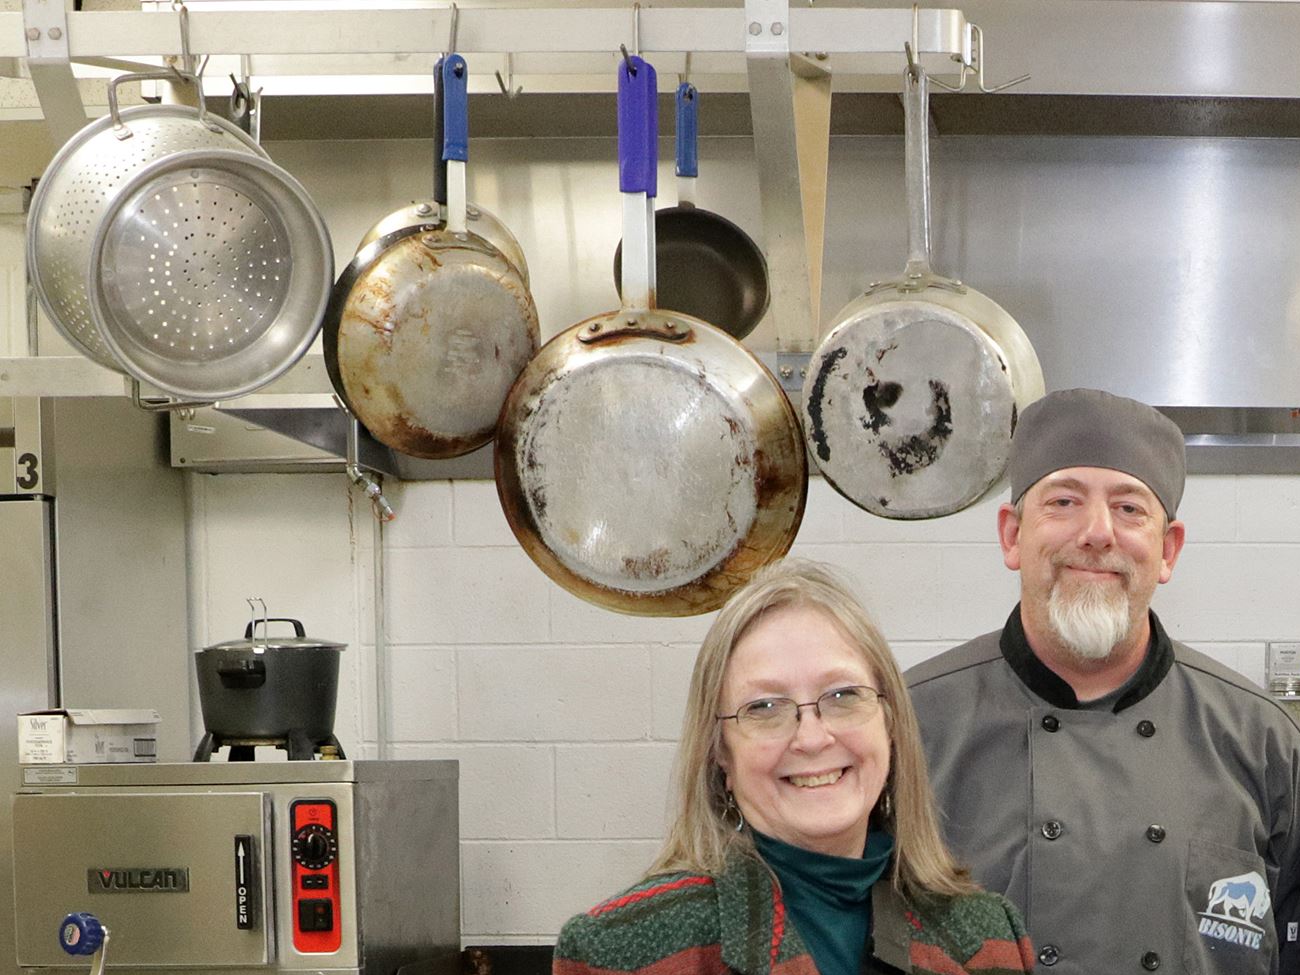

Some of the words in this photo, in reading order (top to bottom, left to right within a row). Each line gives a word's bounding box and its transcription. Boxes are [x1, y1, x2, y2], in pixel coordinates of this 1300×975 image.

[16, 451, 39, 490] 3
[97, 870, 177, 889] VULCAN
[237, 887, 247, 924] OPEN
[1198, 917, 1262, 950] BISONTE
